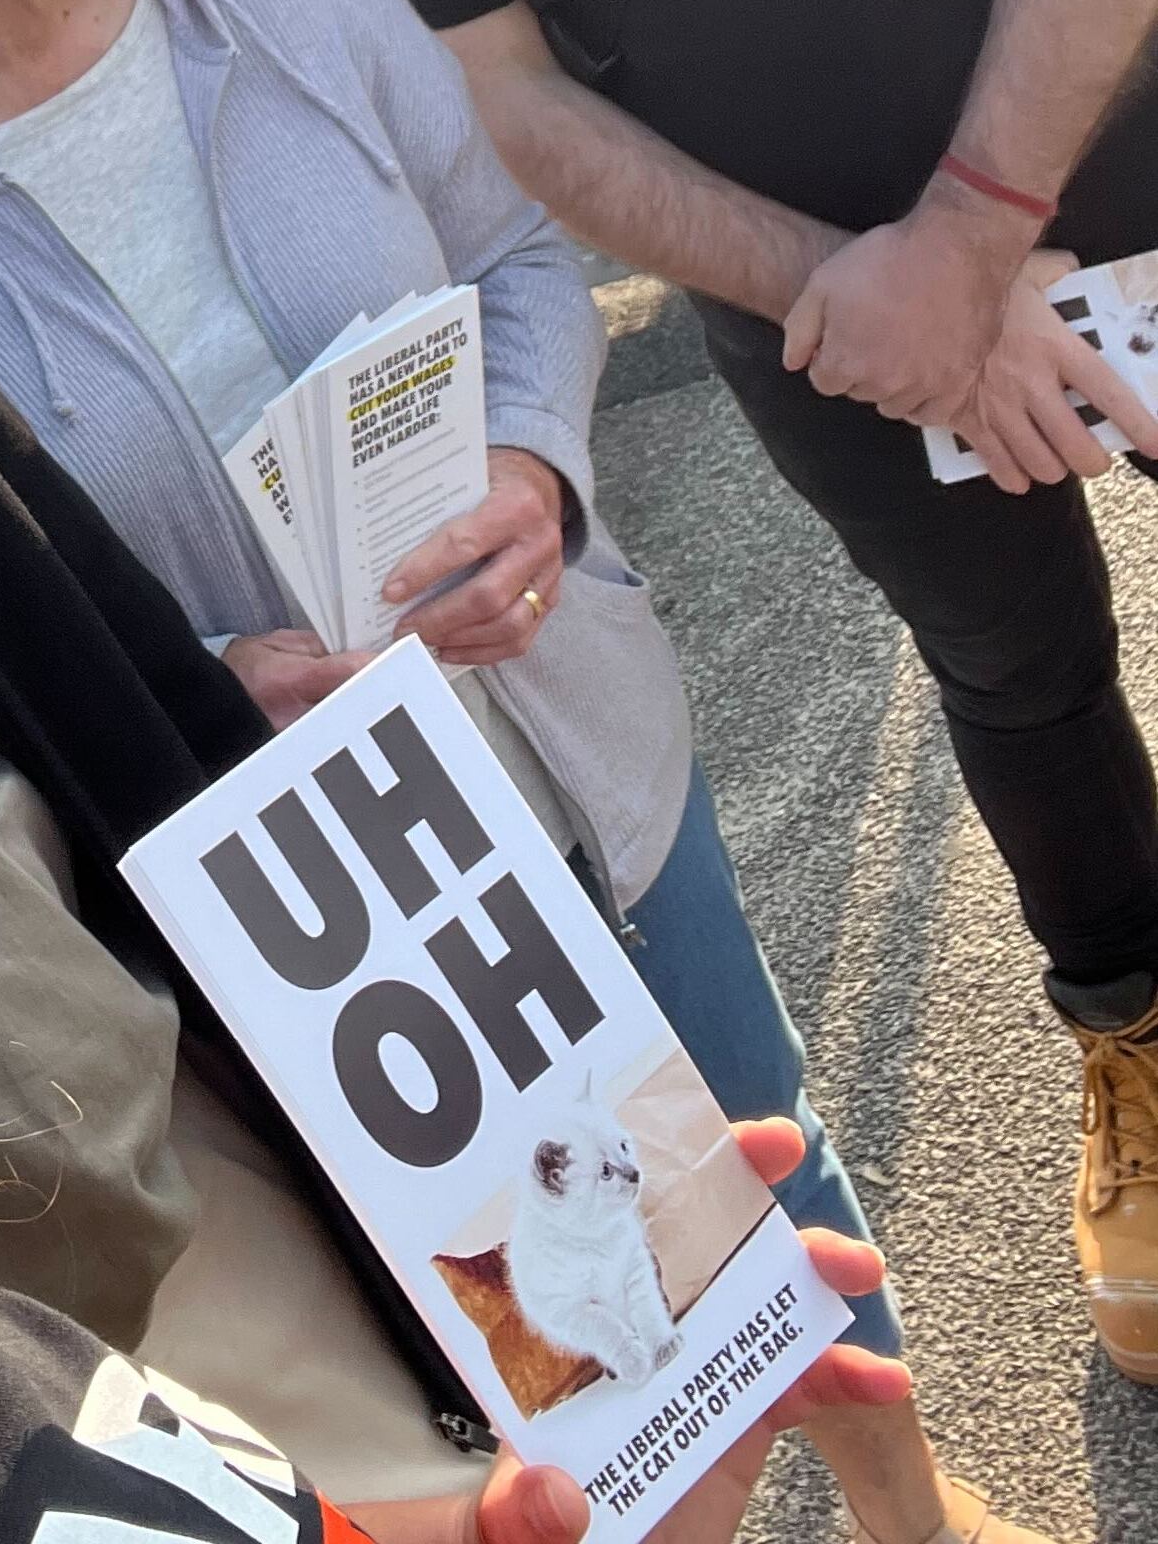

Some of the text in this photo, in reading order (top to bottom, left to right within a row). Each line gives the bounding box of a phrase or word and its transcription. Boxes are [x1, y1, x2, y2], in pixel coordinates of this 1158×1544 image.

[348, 317, 464, 390] THE LIBERAL PARTY
[349, 332, 468, 406] HAS A NEW PLAN TO
[350, 356, 454, 421] CUT YOUR WAGES
[351, 373, 452, 437] AND MAKE YOUR
[250, 437, 274, 466] THE
[351, 394, 440, 452] WORKING LIFE
[353, 441, 384, 469] EVEN
[257, 457, 278, 478] HA
[265, 467, 282, 490] CU
[198, 703, 497, 992] UH
[332, 869, 607, 1169] OH
[584, 1283, 798, 1505] THE LIBERAL PARTY HAS LET
[607, 1319, 804, 1517] THE CAT OUT OF THE BAG.
